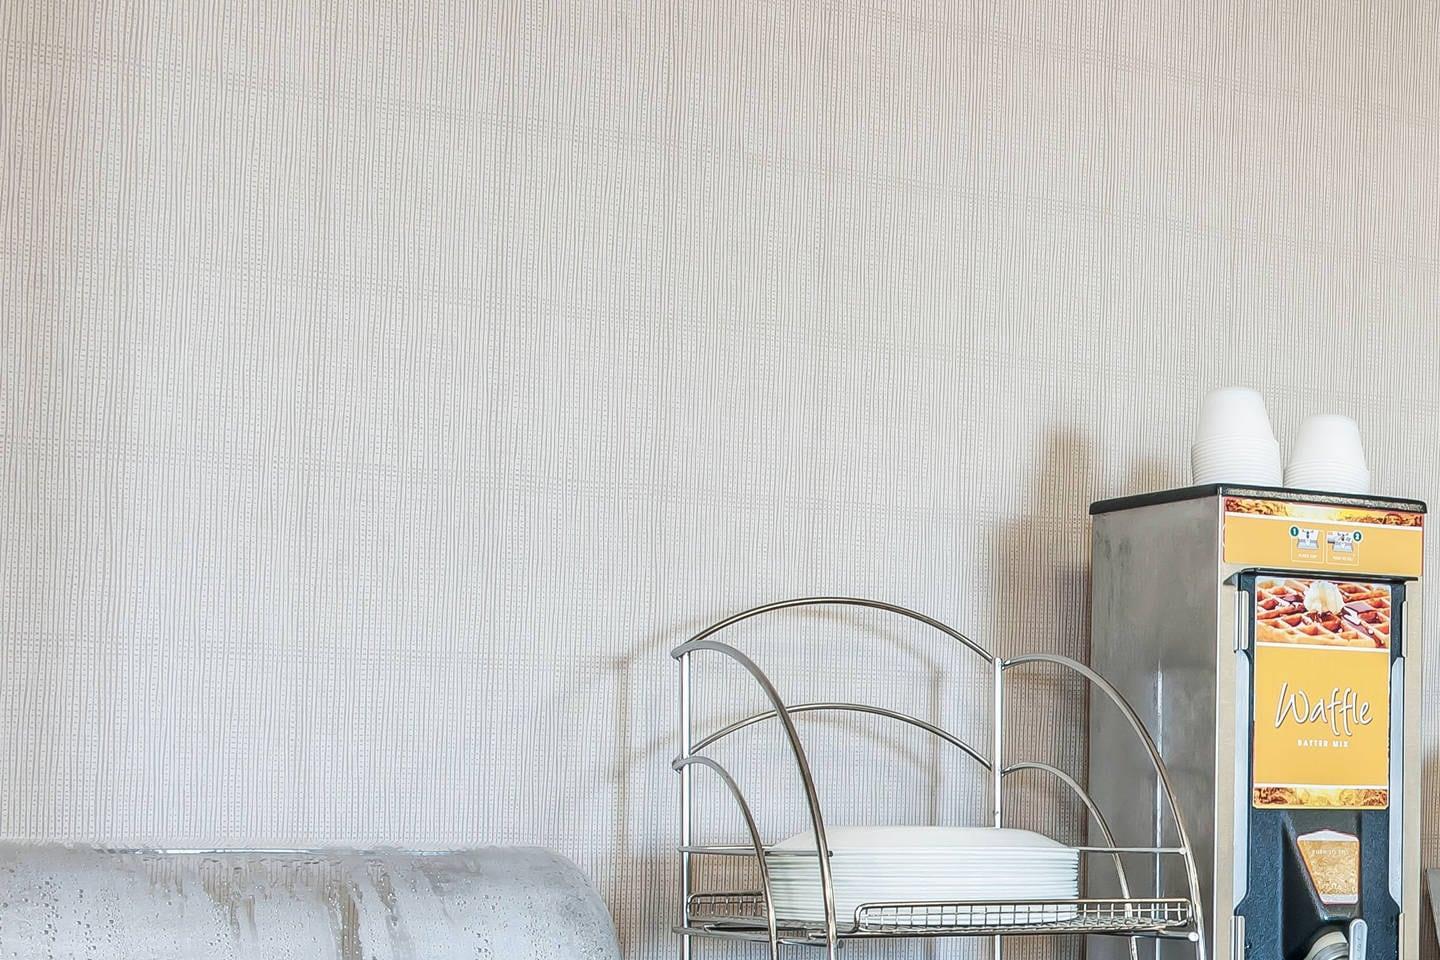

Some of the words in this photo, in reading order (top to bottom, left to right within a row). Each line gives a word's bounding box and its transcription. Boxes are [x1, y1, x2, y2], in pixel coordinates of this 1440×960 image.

[1274, 682, 1373, 736] Waffle
[1297, 738, 1328, 748] BATTER
[1332, 739, 1349, 748] MIX
